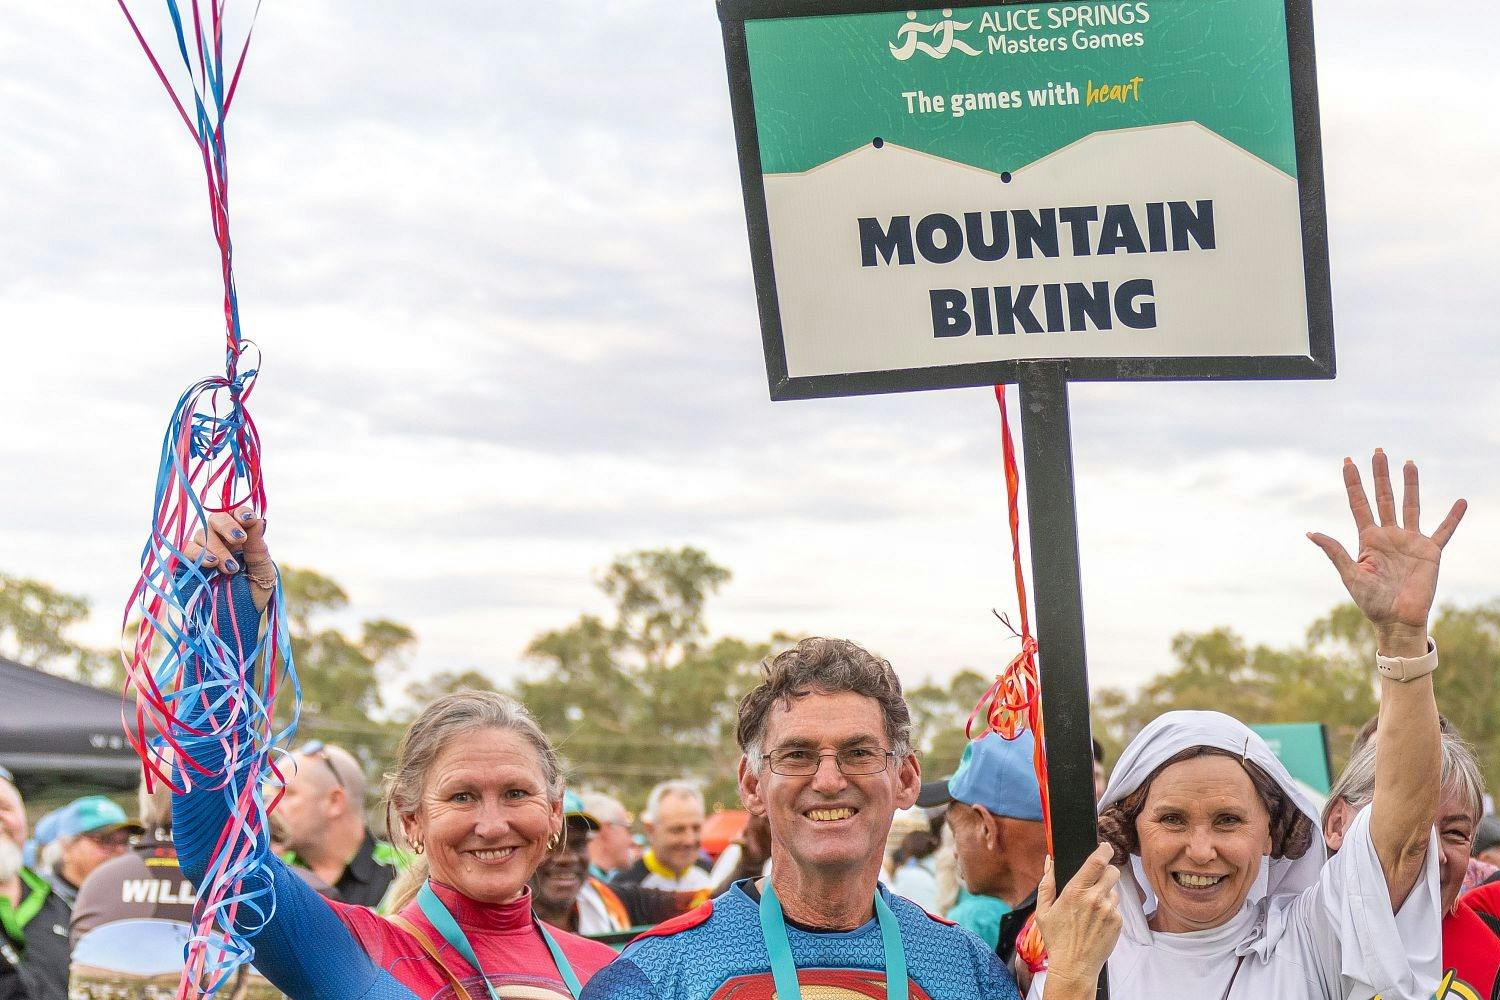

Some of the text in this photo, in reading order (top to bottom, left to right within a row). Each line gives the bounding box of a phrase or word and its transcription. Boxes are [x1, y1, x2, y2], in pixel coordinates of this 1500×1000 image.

[979, 2, 1150, 33] ALICE SPRINGS
[988, 29, 1145, 54] Masters Games
[902, 76, 1143, 118] The games with heart
[858, 200, 1215, 266] MOUNTAIN
[929, 279, 1156, 338] BIKING
